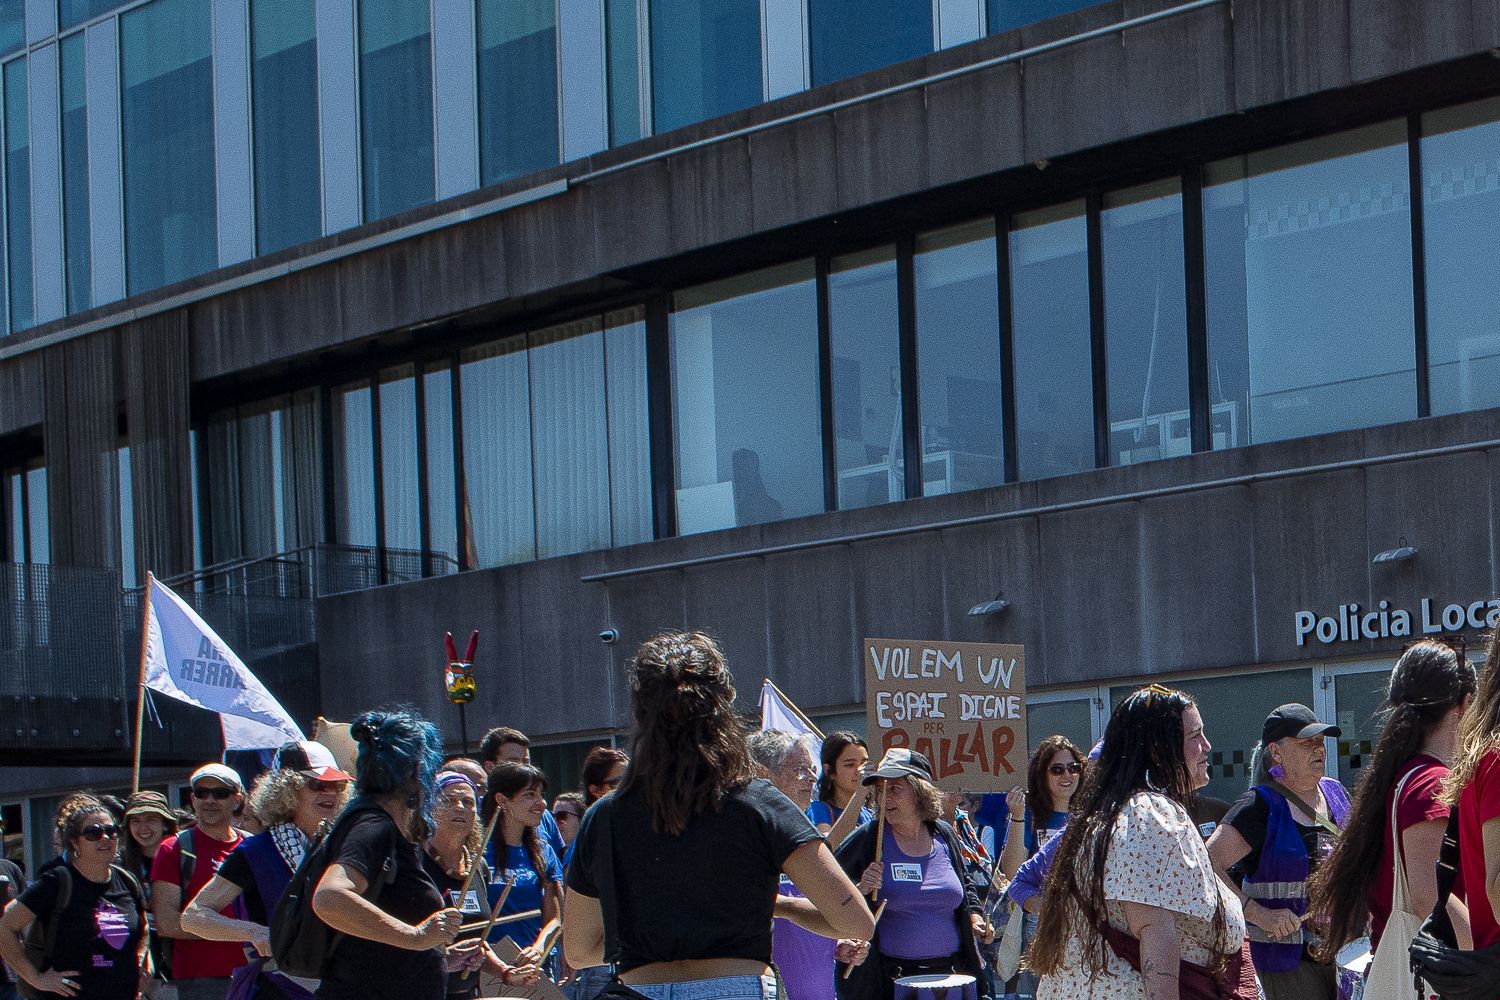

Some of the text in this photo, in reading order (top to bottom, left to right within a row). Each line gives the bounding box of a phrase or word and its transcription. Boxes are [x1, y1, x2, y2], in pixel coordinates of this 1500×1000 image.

[1295, 600, 1411, 646] Policia
[870, 646, 1017, 689] VOLEM UN
[876, 690, 1021, 728] ESPAI DIGNE
[923, 722, 945, 735] PER
